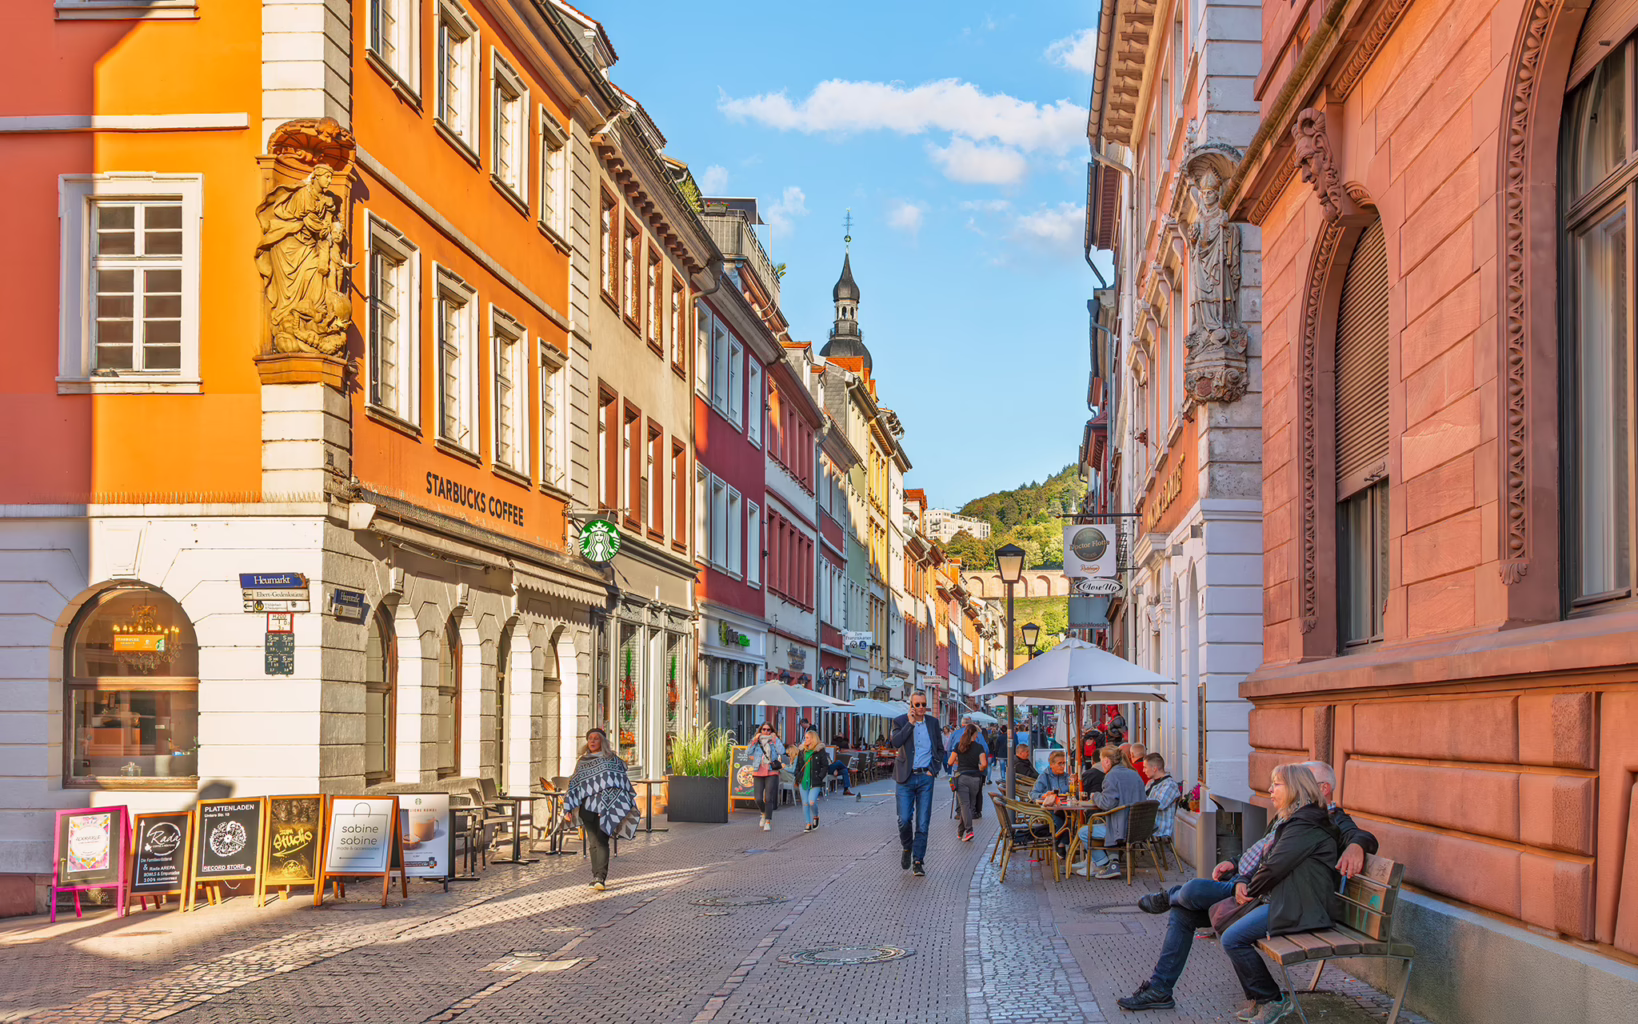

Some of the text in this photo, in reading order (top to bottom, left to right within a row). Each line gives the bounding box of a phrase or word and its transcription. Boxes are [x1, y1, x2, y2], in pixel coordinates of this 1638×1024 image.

[426, 471, 524, 527] STARBUCKS COFFEE
[254, 574, 291, 585] Heumarkt
[204, 804, 255, 812] PLATTENLADEN
[342, 824, 378, 834] sabine
[273, 828, 313, 851] Studio
[340, 836, 378, 846] sabine
